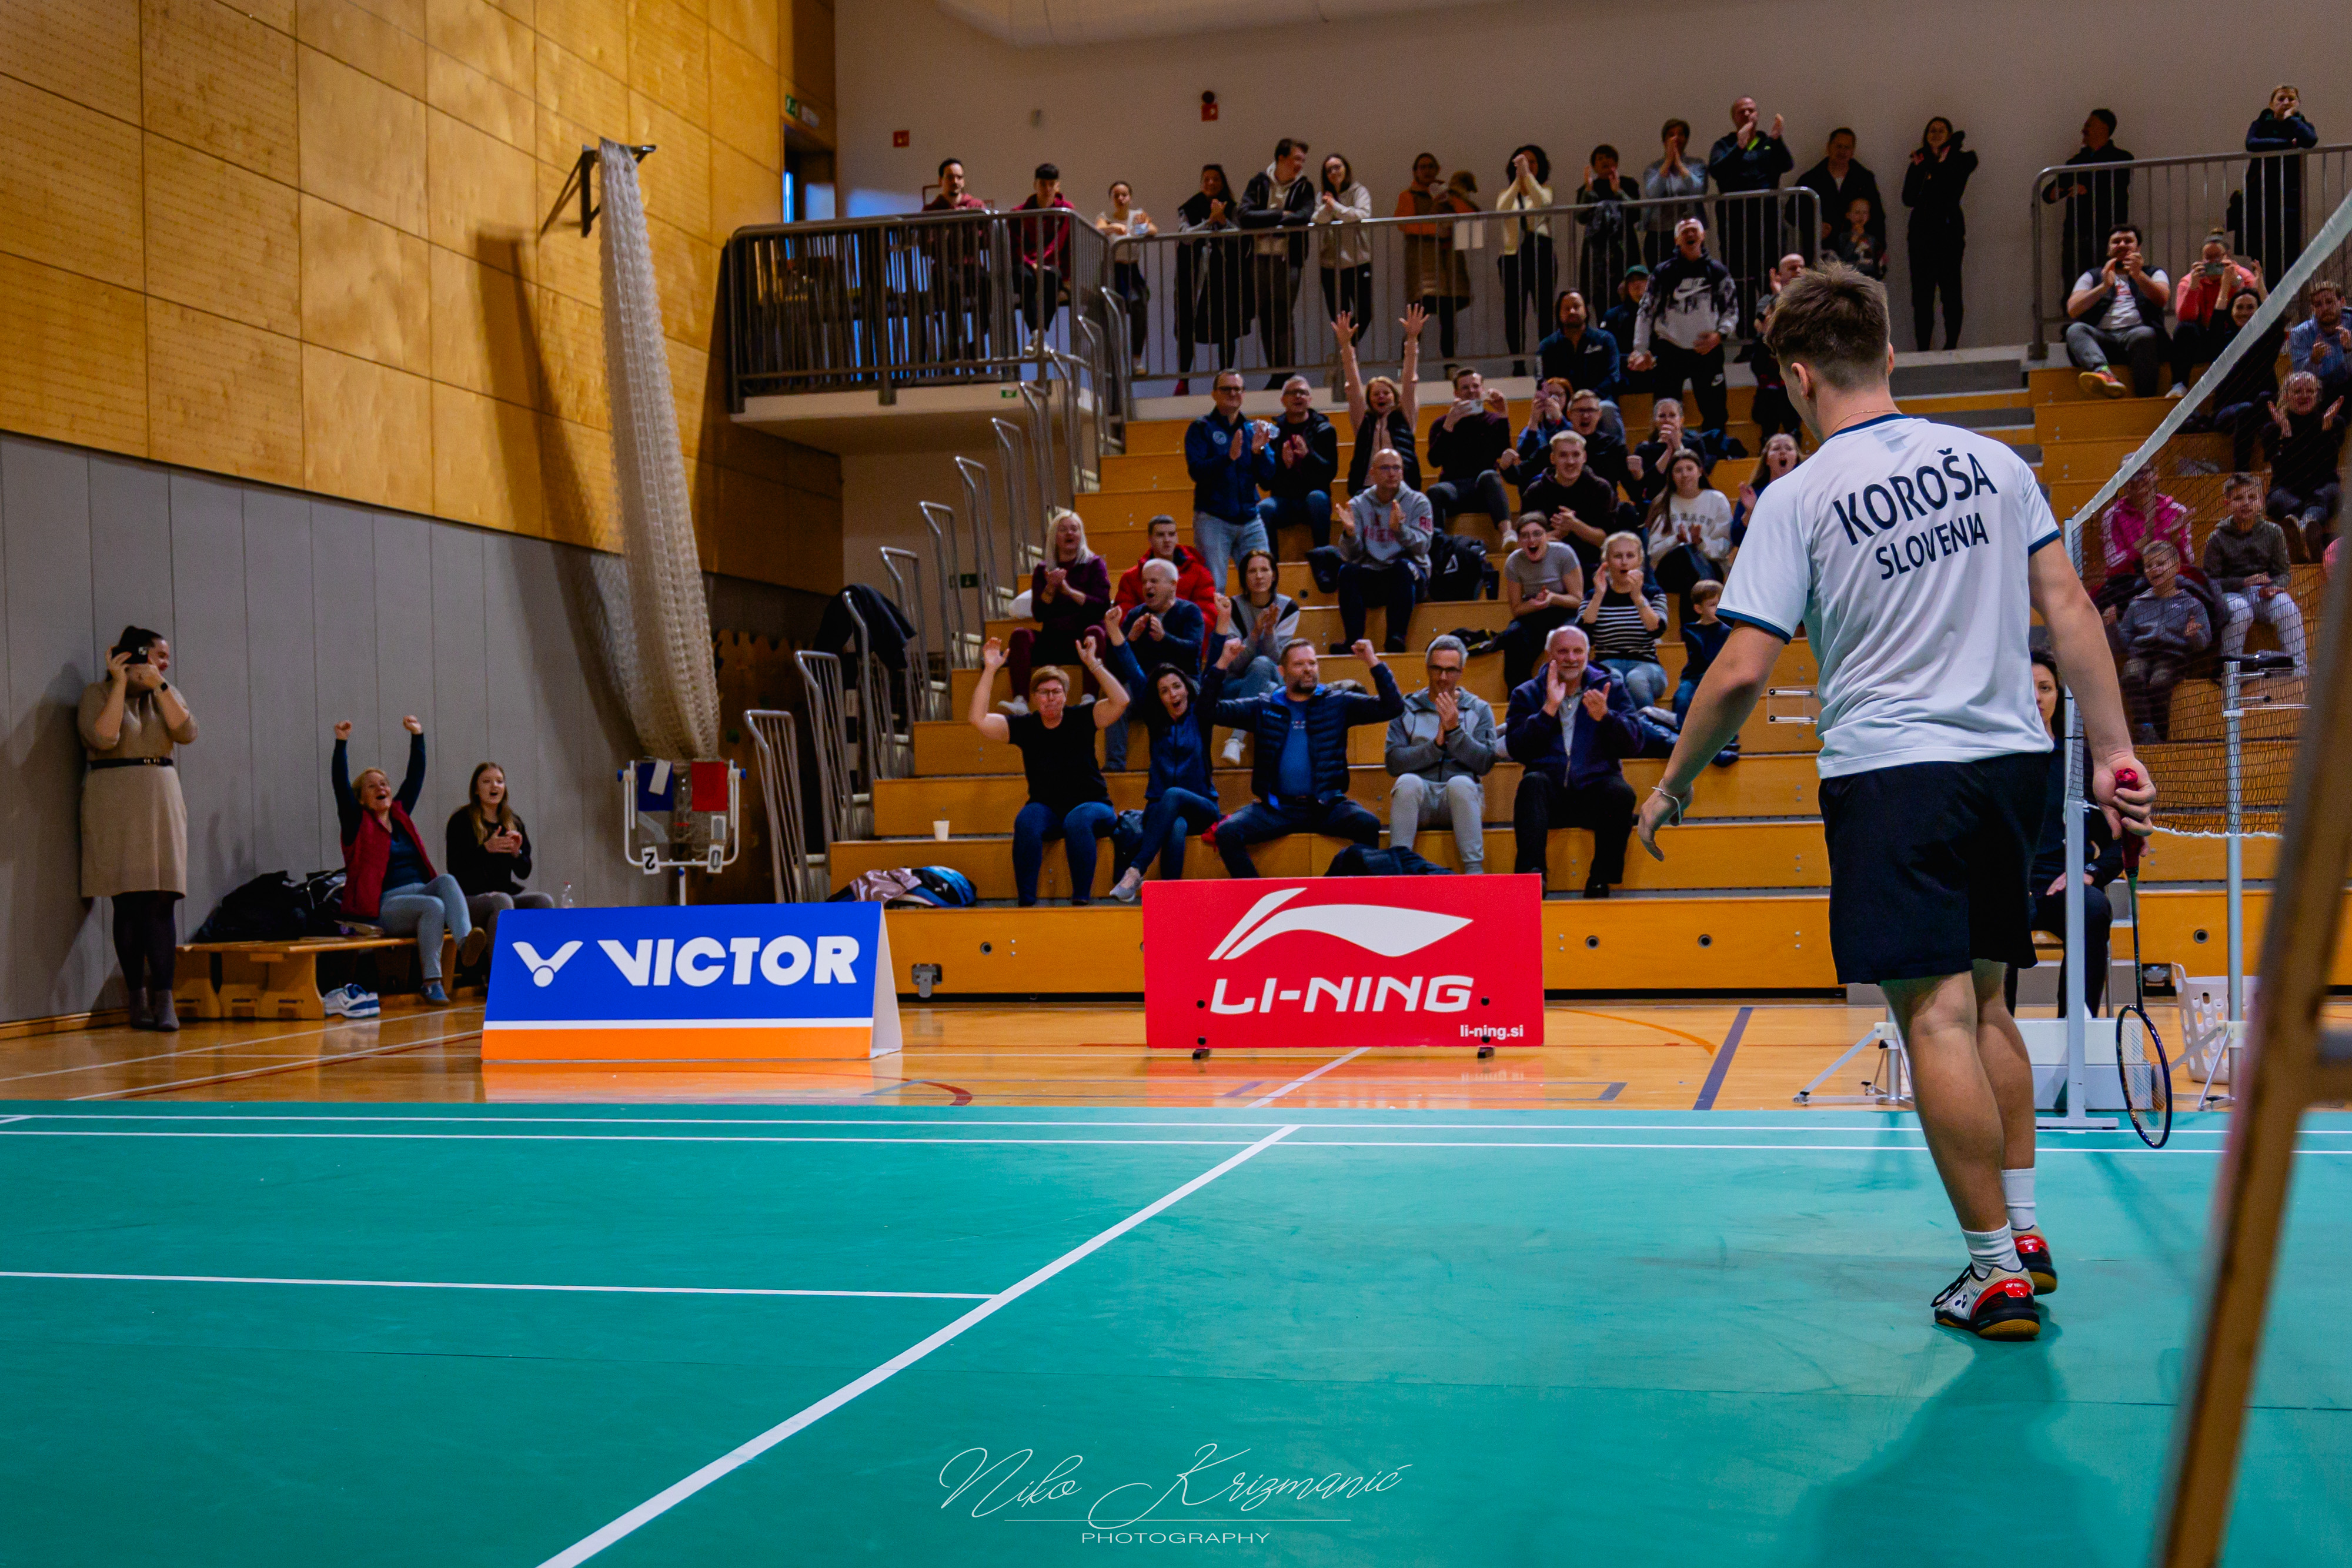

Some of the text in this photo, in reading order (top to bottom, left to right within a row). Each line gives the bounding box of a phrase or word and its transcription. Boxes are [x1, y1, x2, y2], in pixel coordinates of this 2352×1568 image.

[1832, 447, 1998, 546] KOROŠA
[1875, 512, 1990, 580] SLOVENIA
[597, 935, 860, 987] VICTOR
[1210, 975, 1474, 1014] LI-NING
[1460, 1024, 1524, 1041] li-ning.si
